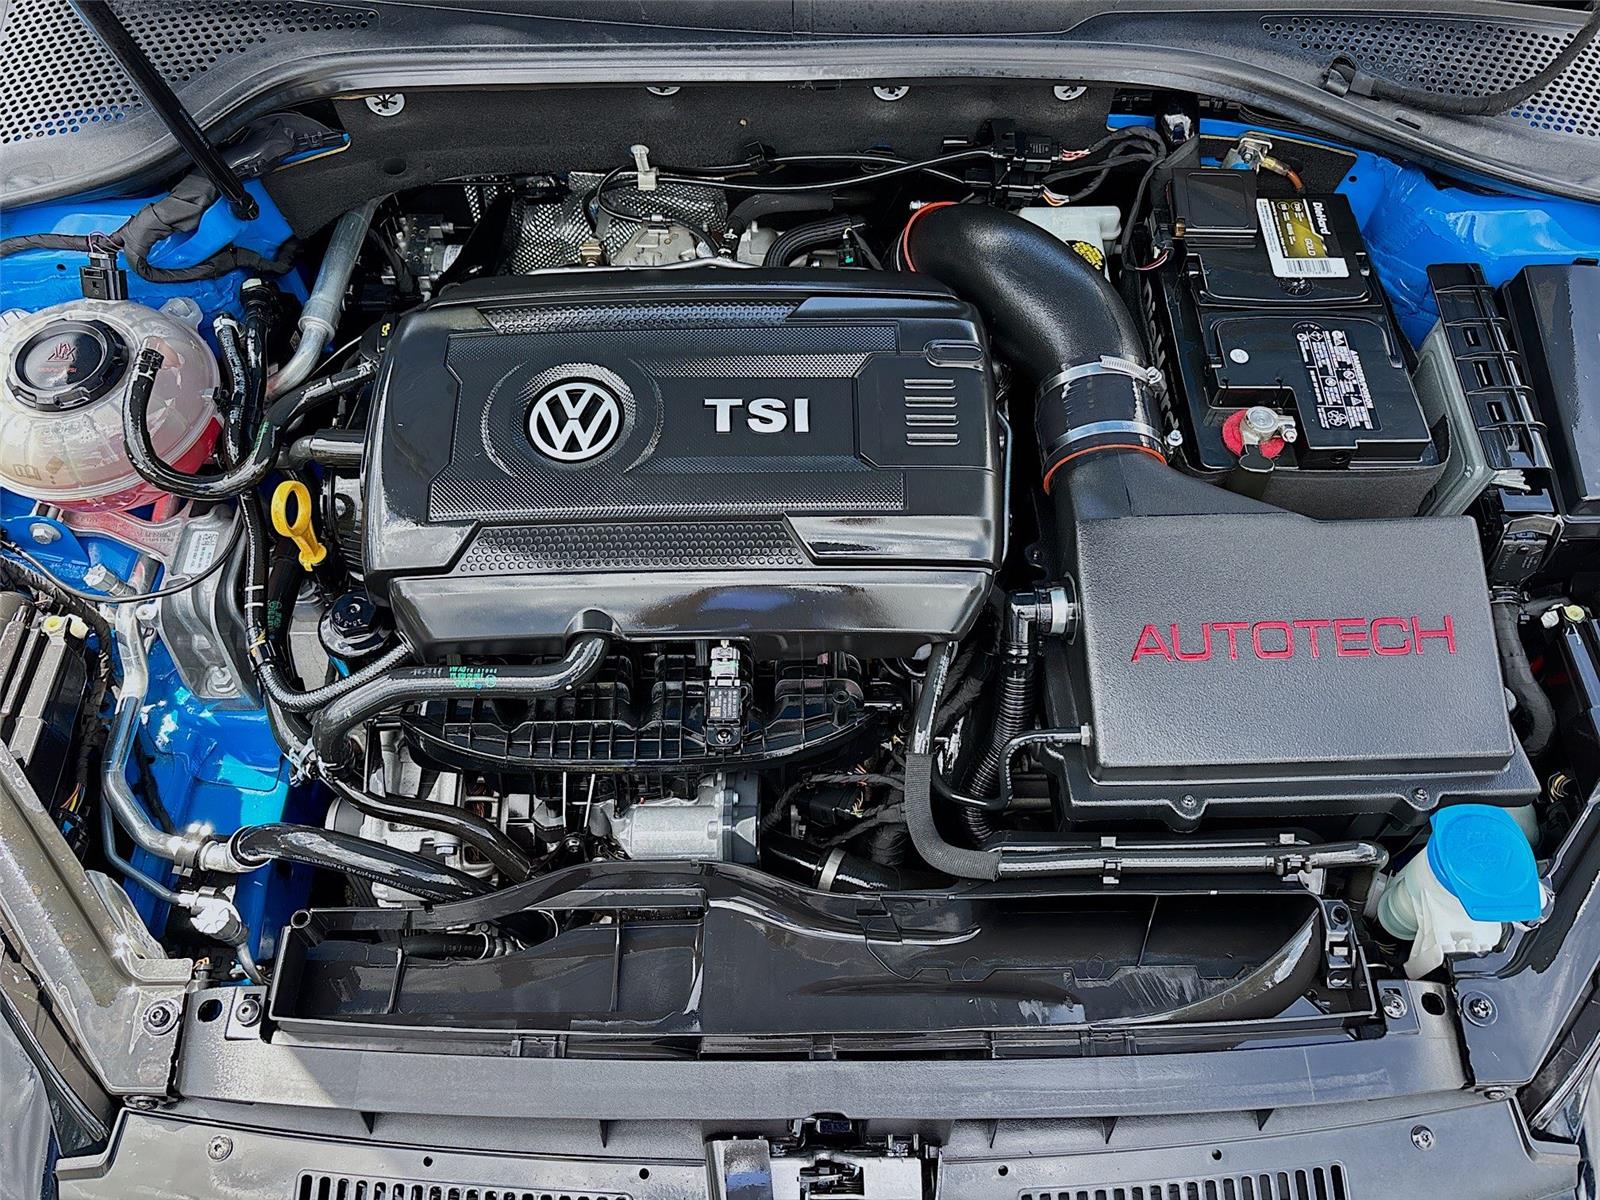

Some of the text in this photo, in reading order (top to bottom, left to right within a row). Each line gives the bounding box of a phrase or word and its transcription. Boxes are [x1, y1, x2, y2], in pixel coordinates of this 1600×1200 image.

[1312, 201, 1331, 235] DieHard
[1304, 237, 1316, 256] GOLD
[529, 382, 620, 461] VW
[704, 398, 810, 433] TSI
[1131, 614, 1456, 663] AUTOTECH
